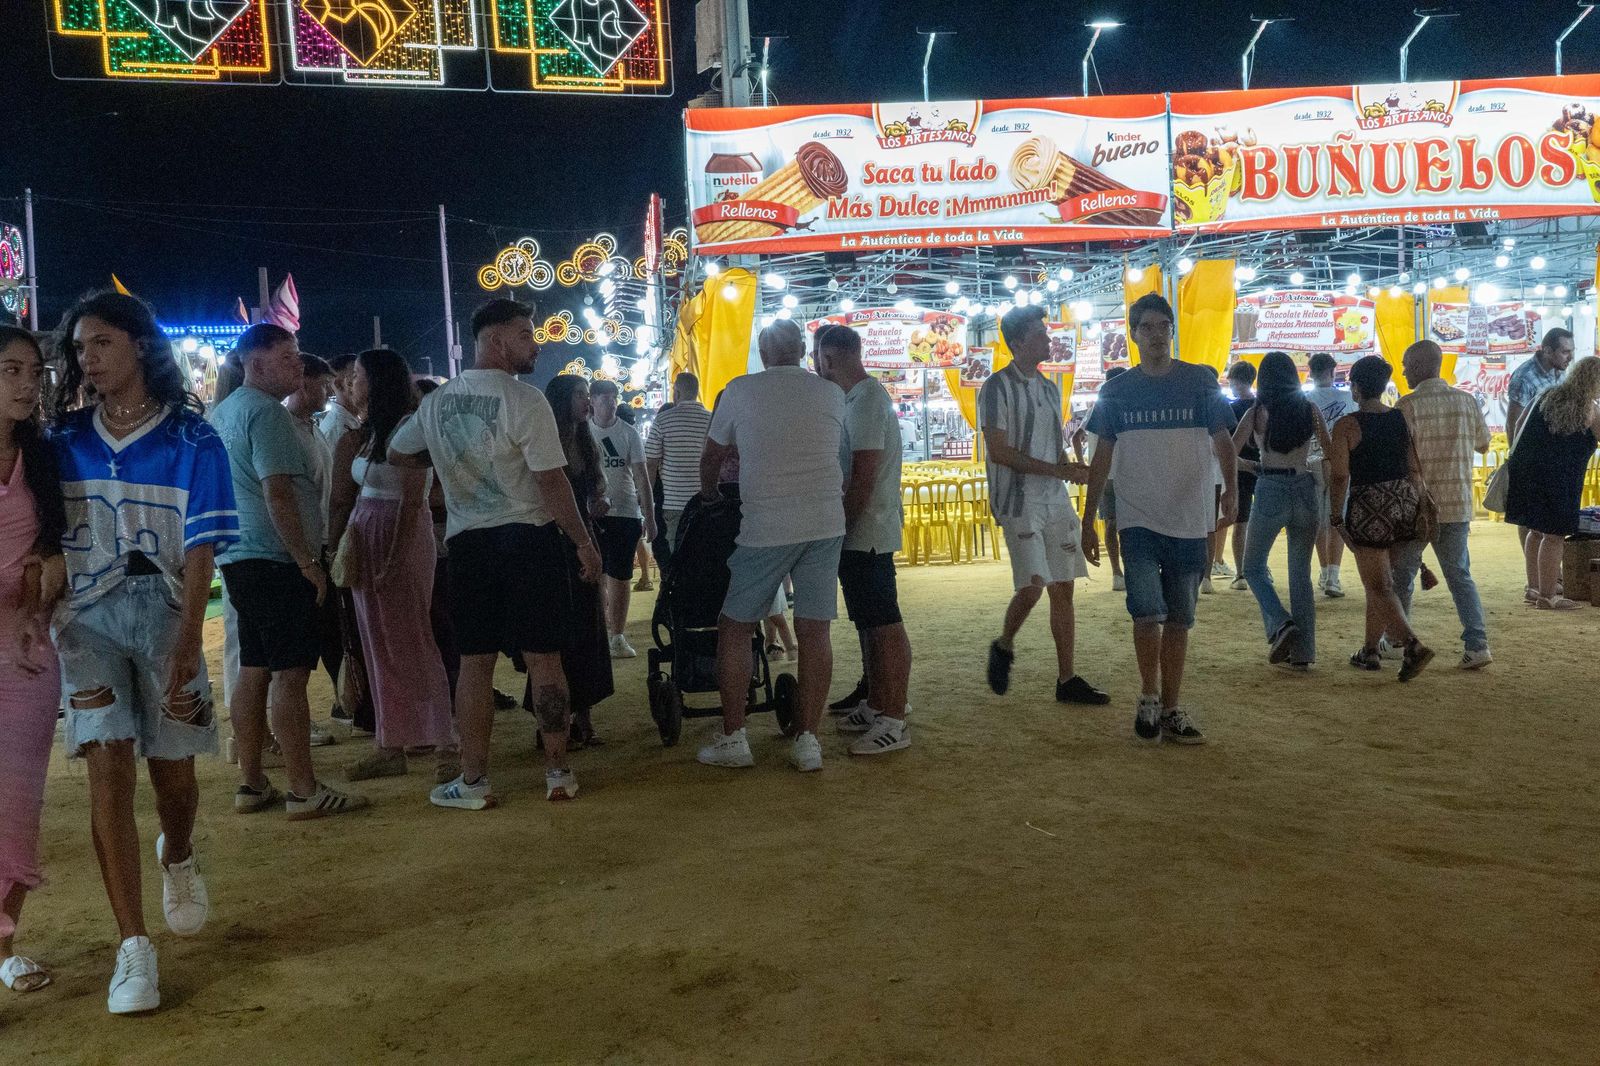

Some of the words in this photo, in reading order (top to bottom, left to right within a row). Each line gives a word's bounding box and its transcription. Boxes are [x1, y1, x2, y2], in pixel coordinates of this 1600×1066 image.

[1316, 111, 1332, 119] 1932
[1490, 103, 1506, 111] 1932
[1014, 123, 1030, 131] 1932
[1361, 118, 1380, 130] LOS
[1383, 110, 1452, 127] ARTESANOS
[836, 128, 852, 136] 1932
[882, 136, 901, 149] LOS
[904, 129, 976, 146] ARTESANOS
[1091, 140, 1160, 168] bueno
[863, 162, 915, 185] Saca
[921, 163, 943, 182] tu
[949, 157, 997, 182] lado
[1240, 131, 1576, 201] BUÑUELOS
[713, 173, 758, 186] nutella
[827, 192, 873, 219] Más
[879, 193, 939, 218] Dulce
[1080, 193, 1138, 212] Rellenos
[720, 204, 779, 219] Rellenos
[1321, 216, 1336, 226] La
[1340, 212, 1401, 225] Auténtica
[1404, 211, 1419, 222] de
[1422, 210, 1450, 222] toda
[1454, 209, 1466, 220] la
[1469, 208, 1500, 219] Vida
[841, 236, 856, 247] La
[861, 232, 922, 246] Auténtica
[926, 232, 940, 243] de
[945, 231, 974, 243] toda
[978, 230, 989, 242] la
[993, 229, 1024, 241] Vida
[1265, 310, 1301, 319] Chocolate
[1302, 310, 1328, 319] Helado
[867, 326, 902, 337] Buñuelos
[1255, 320, 1294, 329] Granizados
[1296, 319, 1334, 328] Artesanales
[1123, 408, 1194, 424] GENERATION
